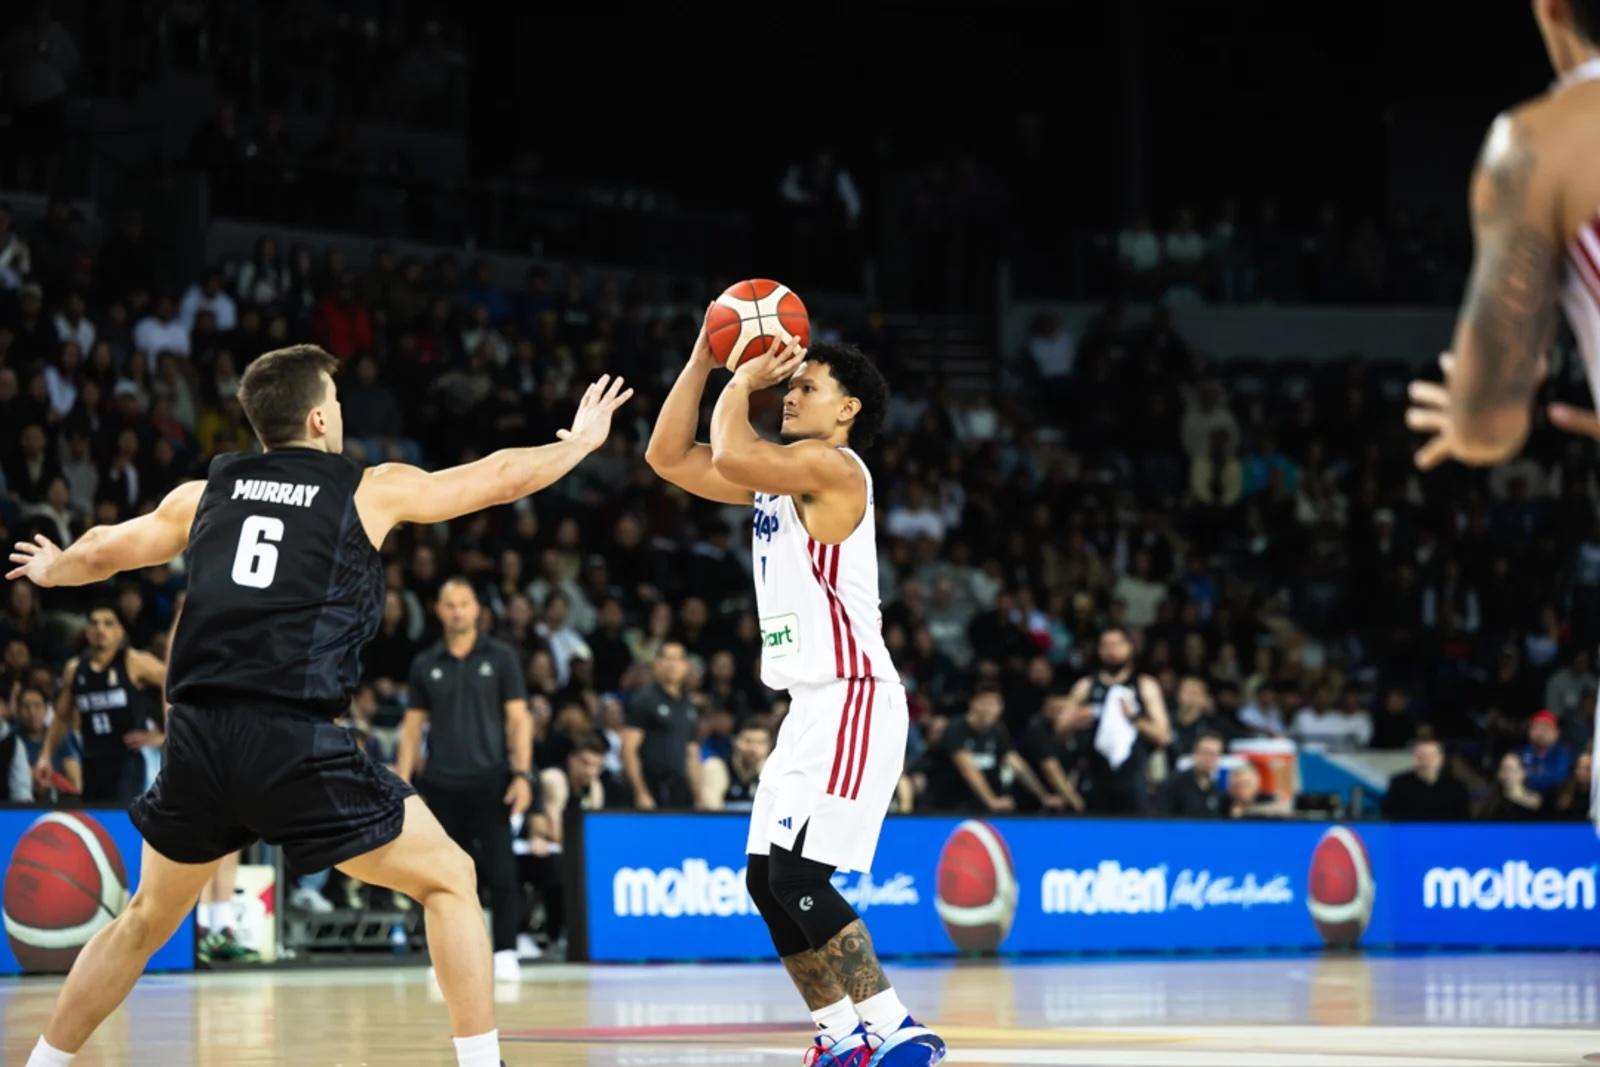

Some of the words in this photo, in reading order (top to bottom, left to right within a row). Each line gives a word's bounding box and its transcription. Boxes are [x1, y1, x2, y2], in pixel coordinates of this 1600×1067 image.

[232, 479, 320, 508] MURRAY
[231, 515, 285, 590] 6
[1041, 860, 1167, 915] molten
[1423, 860, 1596, 911] molten
